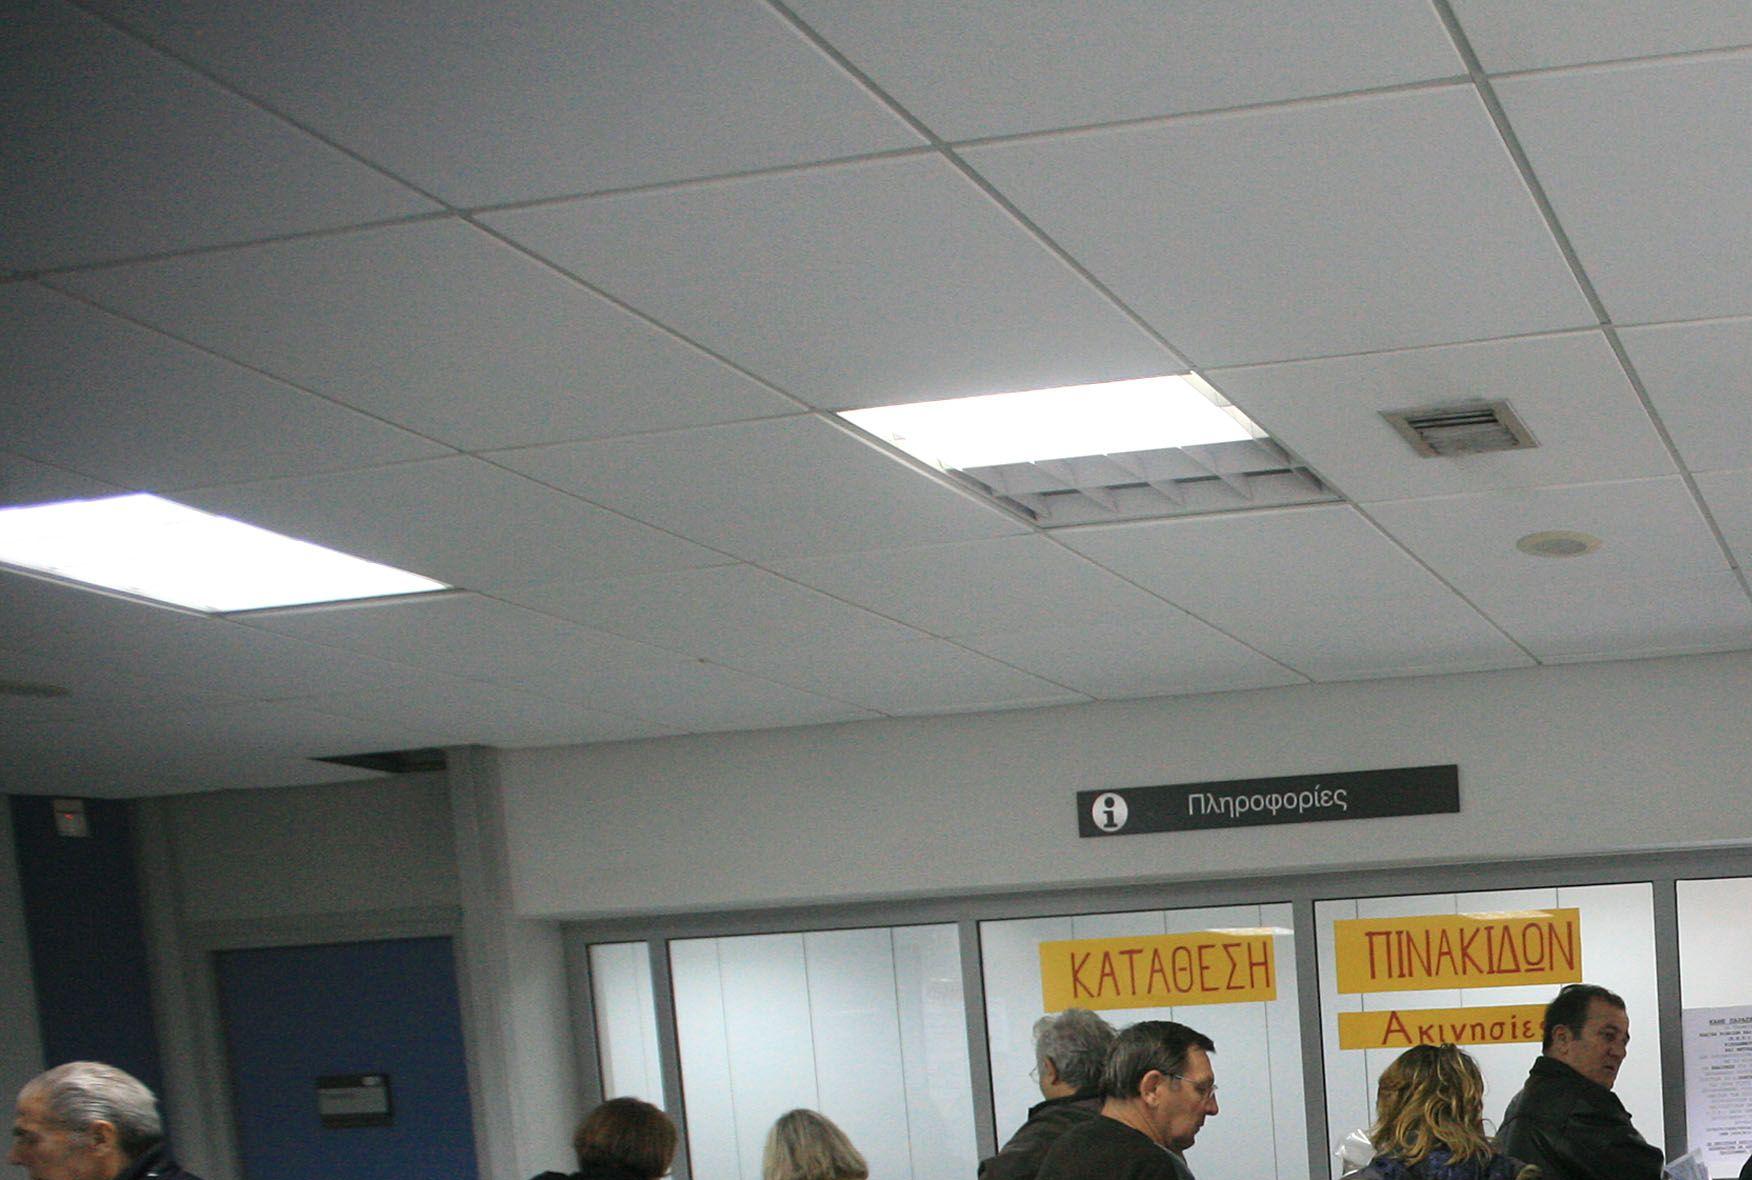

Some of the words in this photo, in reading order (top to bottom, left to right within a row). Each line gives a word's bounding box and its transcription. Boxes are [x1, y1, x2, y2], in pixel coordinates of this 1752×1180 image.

[1187, 784, 1348, 818] Πληροφορίες
[1070, 941, 1271, 999] ΚΑΤΑΘΕΣΗ
[1364, 920, 1575, 980] ΠΙΝΑΚΙΔΩΝ
